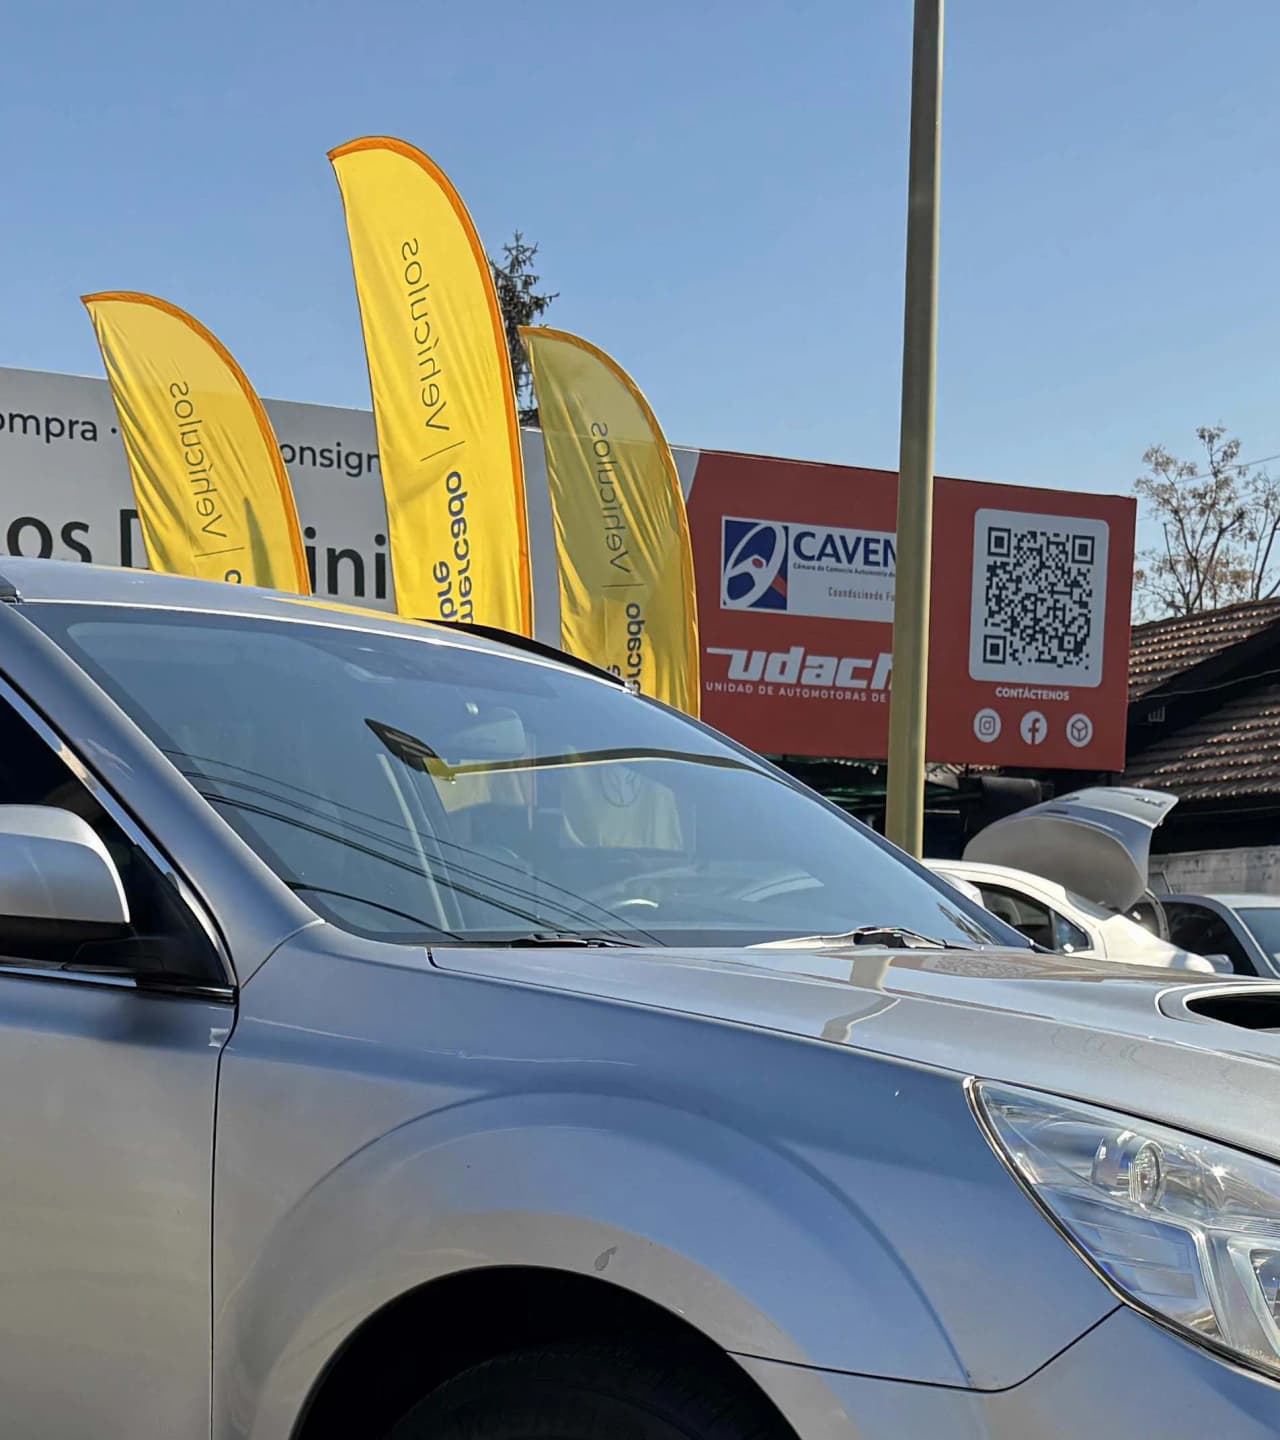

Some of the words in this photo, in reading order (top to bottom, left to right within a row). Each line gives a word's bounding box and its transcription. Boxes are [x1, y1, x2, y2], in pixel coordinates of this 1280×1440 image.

[705, 681, 753, 694] UNIDAD
[758, 685, 774, 696] DE
[778, 687, 868, 702] AUTOMOTORAS
[871, 692, 887, 703] DE
[995, 686, 1070, 701] CONTÁCTENOS
